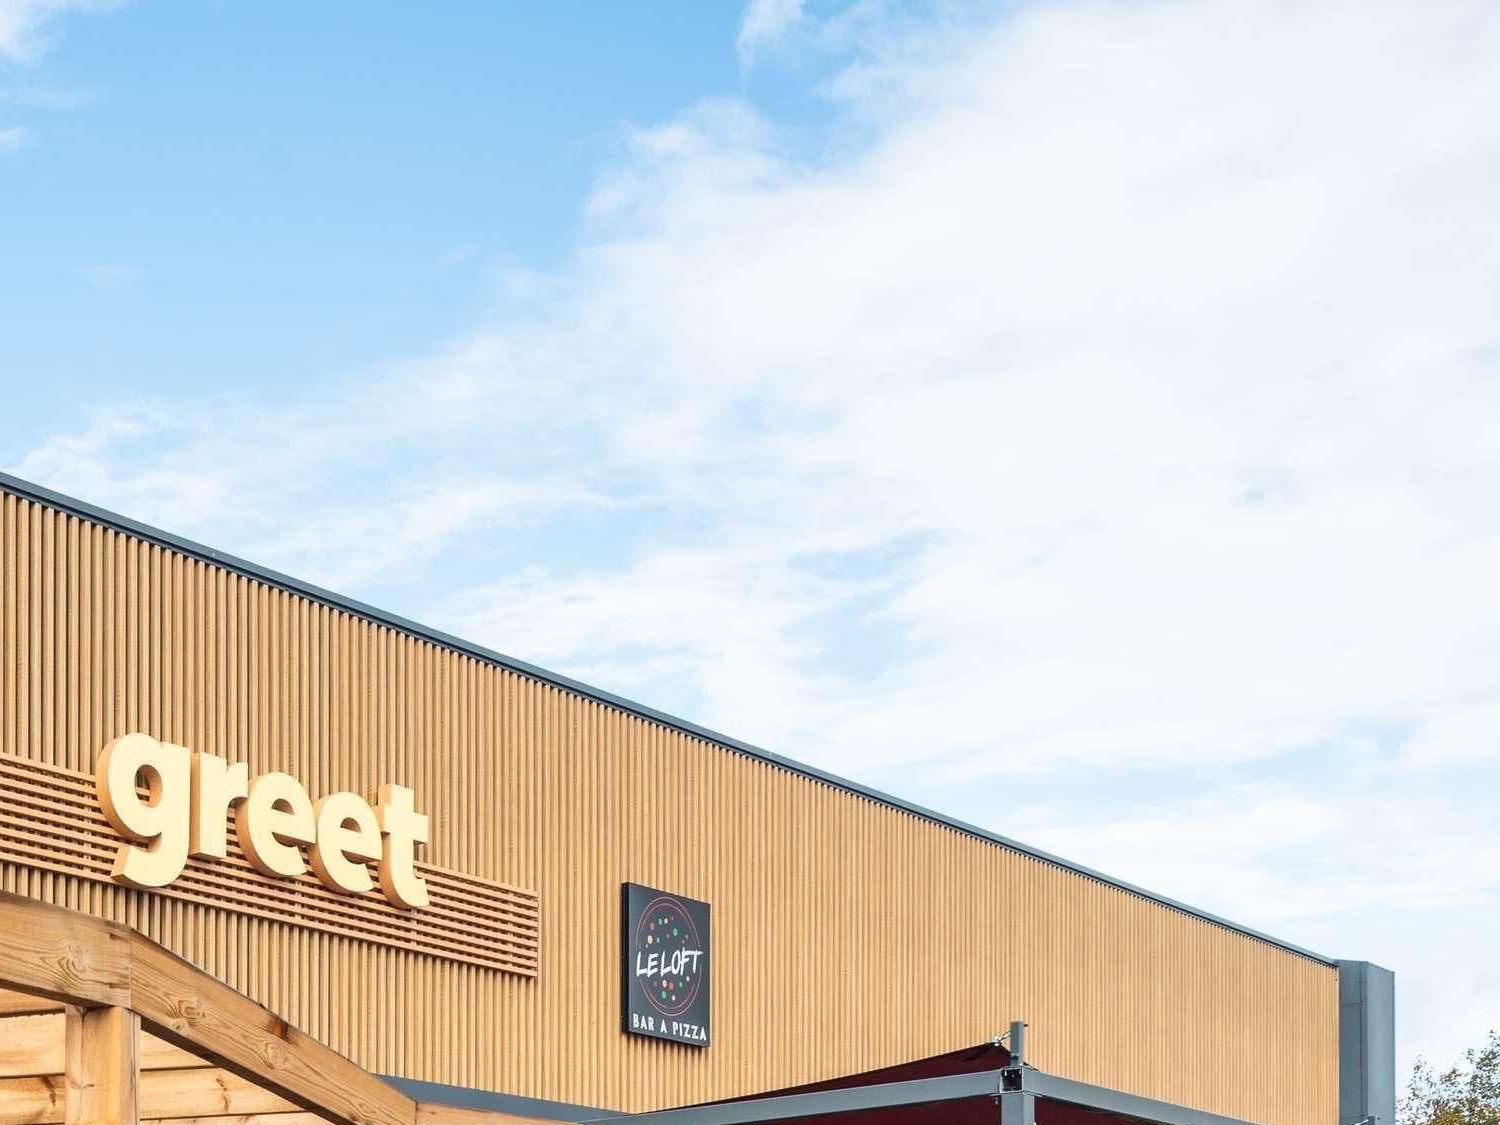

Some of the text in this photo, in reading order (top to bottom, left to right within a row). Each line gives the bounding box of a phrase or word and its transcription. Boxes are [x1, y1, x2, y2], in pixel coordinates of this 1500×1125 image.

[97, 732, 430, 908] greet
[632, 1013, 707, 1041] BAR A PIZZA
